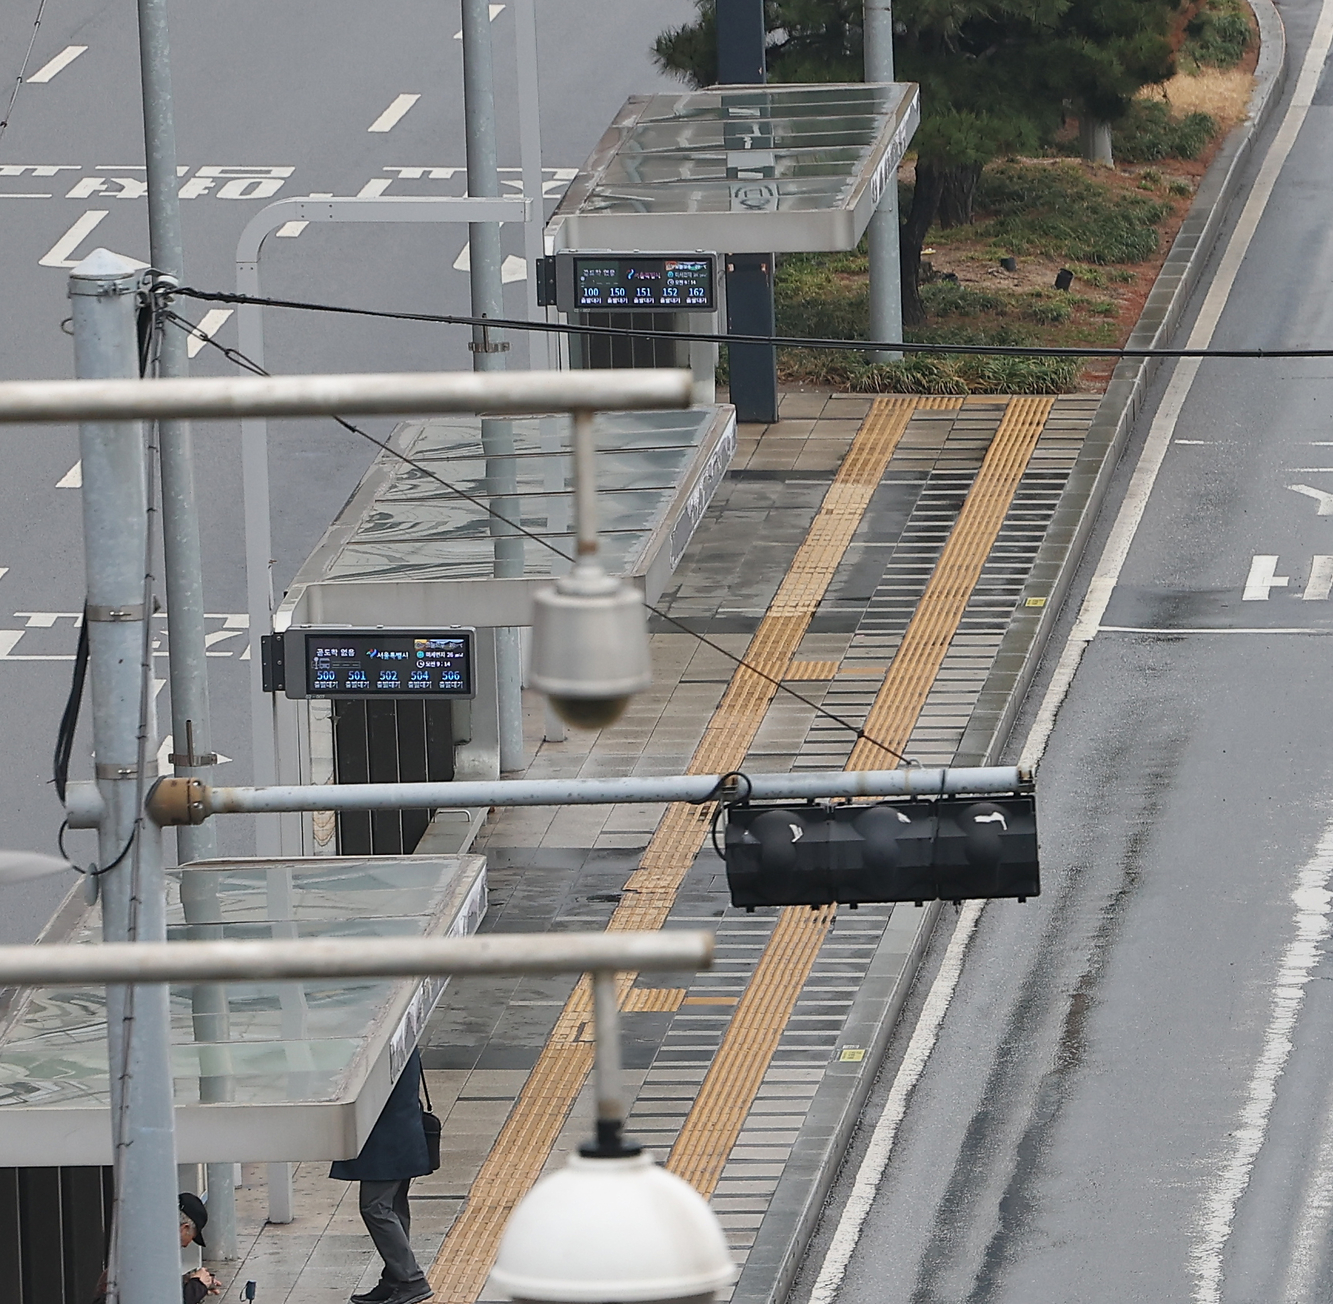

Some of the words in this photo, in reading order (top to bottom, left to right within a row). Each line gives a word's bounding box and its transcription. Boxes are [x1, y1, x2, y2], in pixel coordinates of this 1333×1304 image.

[584, 287, 599, 297] 100
[610, 287, 625, 297] 150
[636, 287, 651, 297] 151
[663, 287, 678, 297] 152
[689, 287, 704, 297] 162
[317, 670, 336, 681] 500
[348, 670, 366, 681] 501
[379, 670, 398, 681] 502
[410, 670, 429, 681] 504
[442, 670, 460, 681] 506
